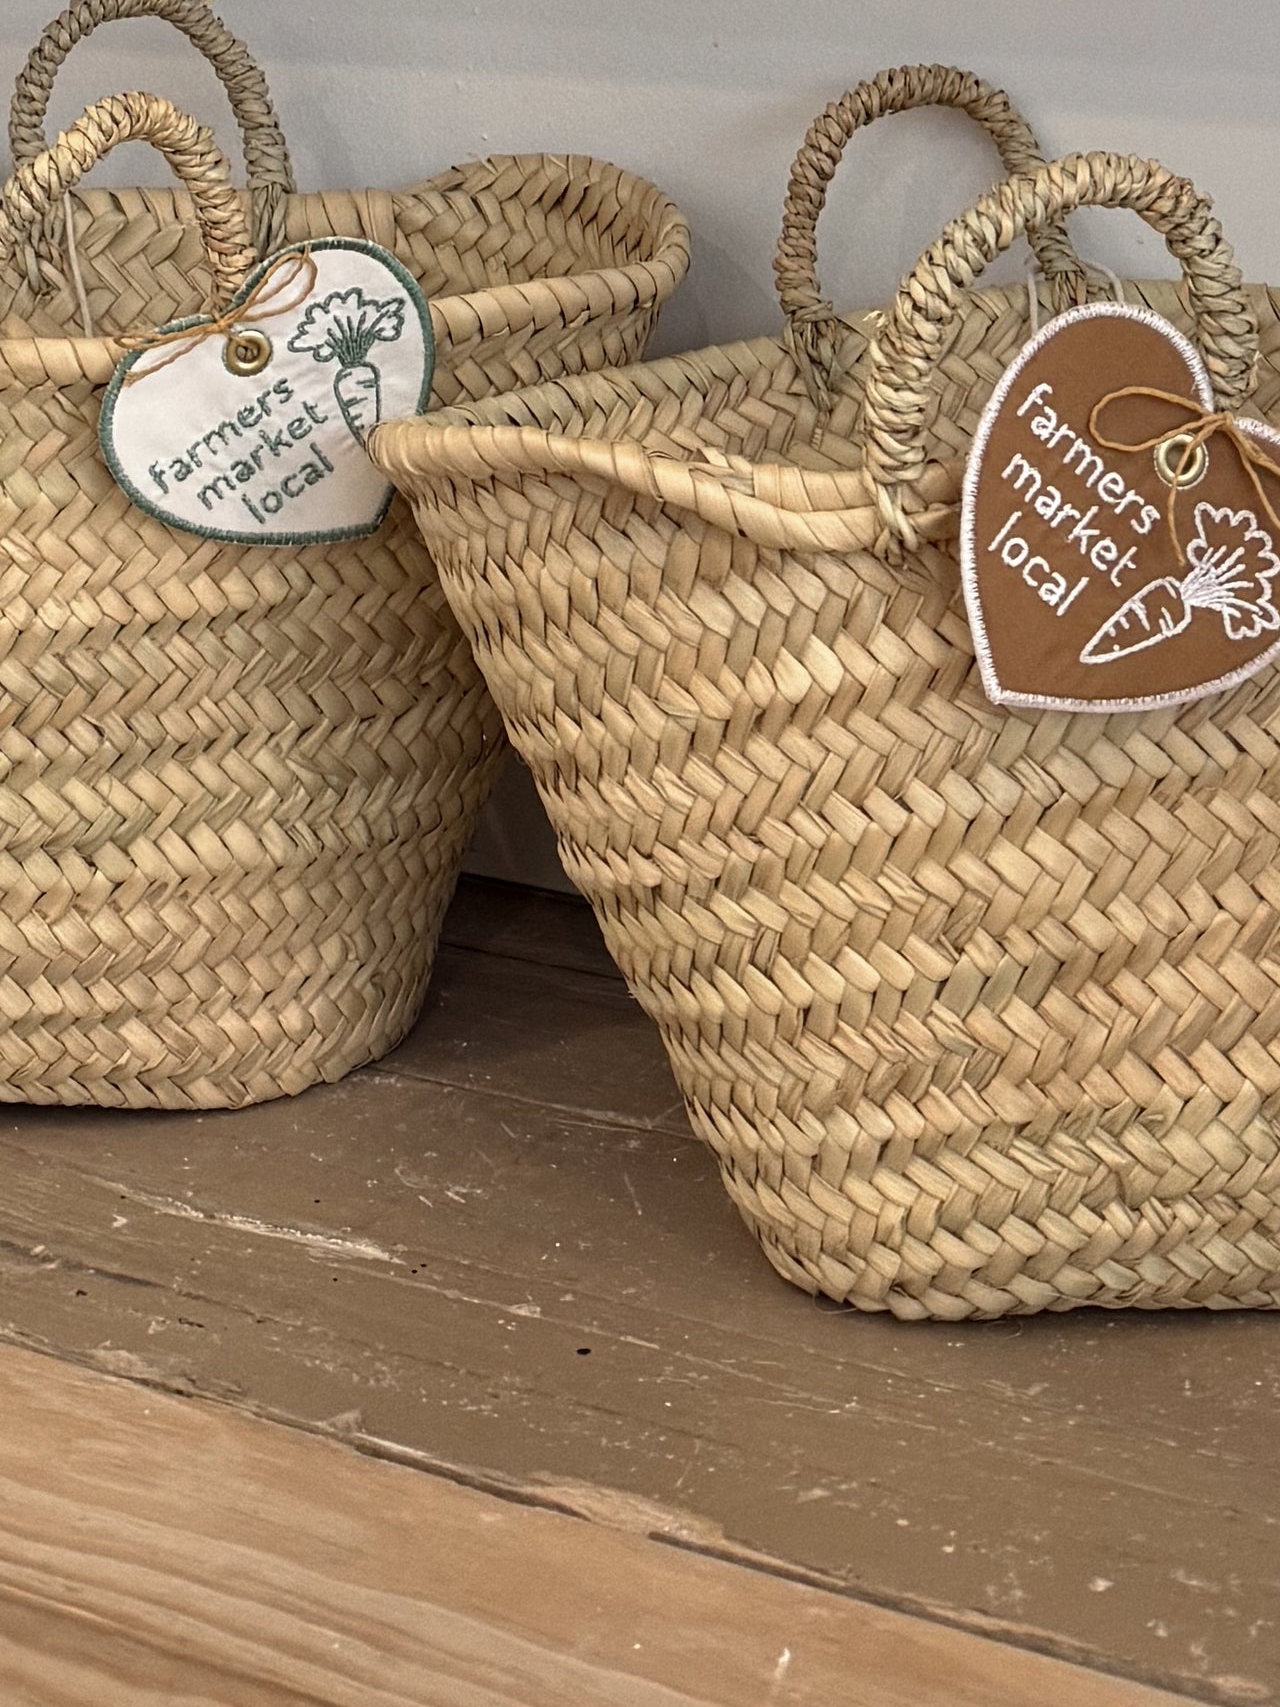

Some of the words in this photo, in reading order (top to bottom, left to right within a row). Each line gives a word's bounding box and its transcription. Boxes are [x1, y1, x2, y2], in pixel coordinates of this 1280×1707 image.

[148, 377, 295, 495] farmers
[196, 400, 329, 511] market
[240, 442, 335, 525] local
[1016, 381, 1162, 535] farmers
[988, 510, 1092, 617] local
[1001, 452, 1137, 588] market
